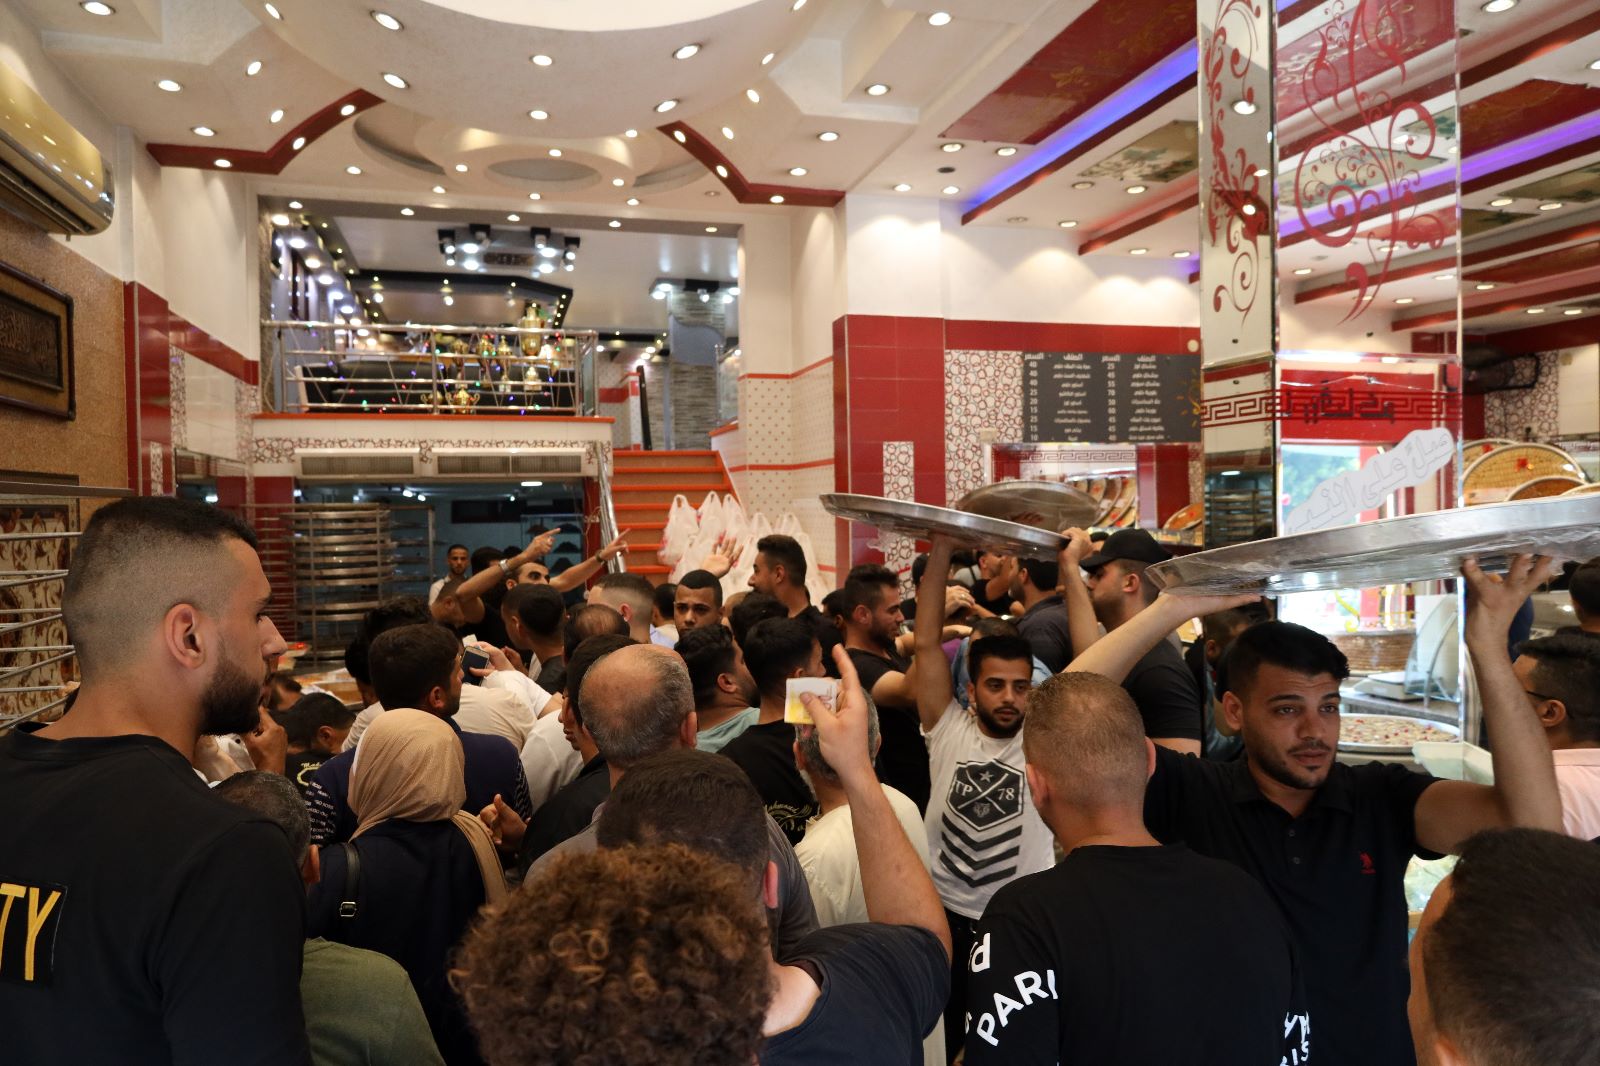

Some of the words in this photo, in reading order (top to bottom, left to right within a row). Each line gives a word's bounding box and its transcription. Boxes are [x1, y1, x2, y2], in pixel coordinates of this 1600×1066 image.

[1362, 457, 1408, 509] على
[997, 787, 1015, 801] 78
[0, 883, 62, 981] TY
